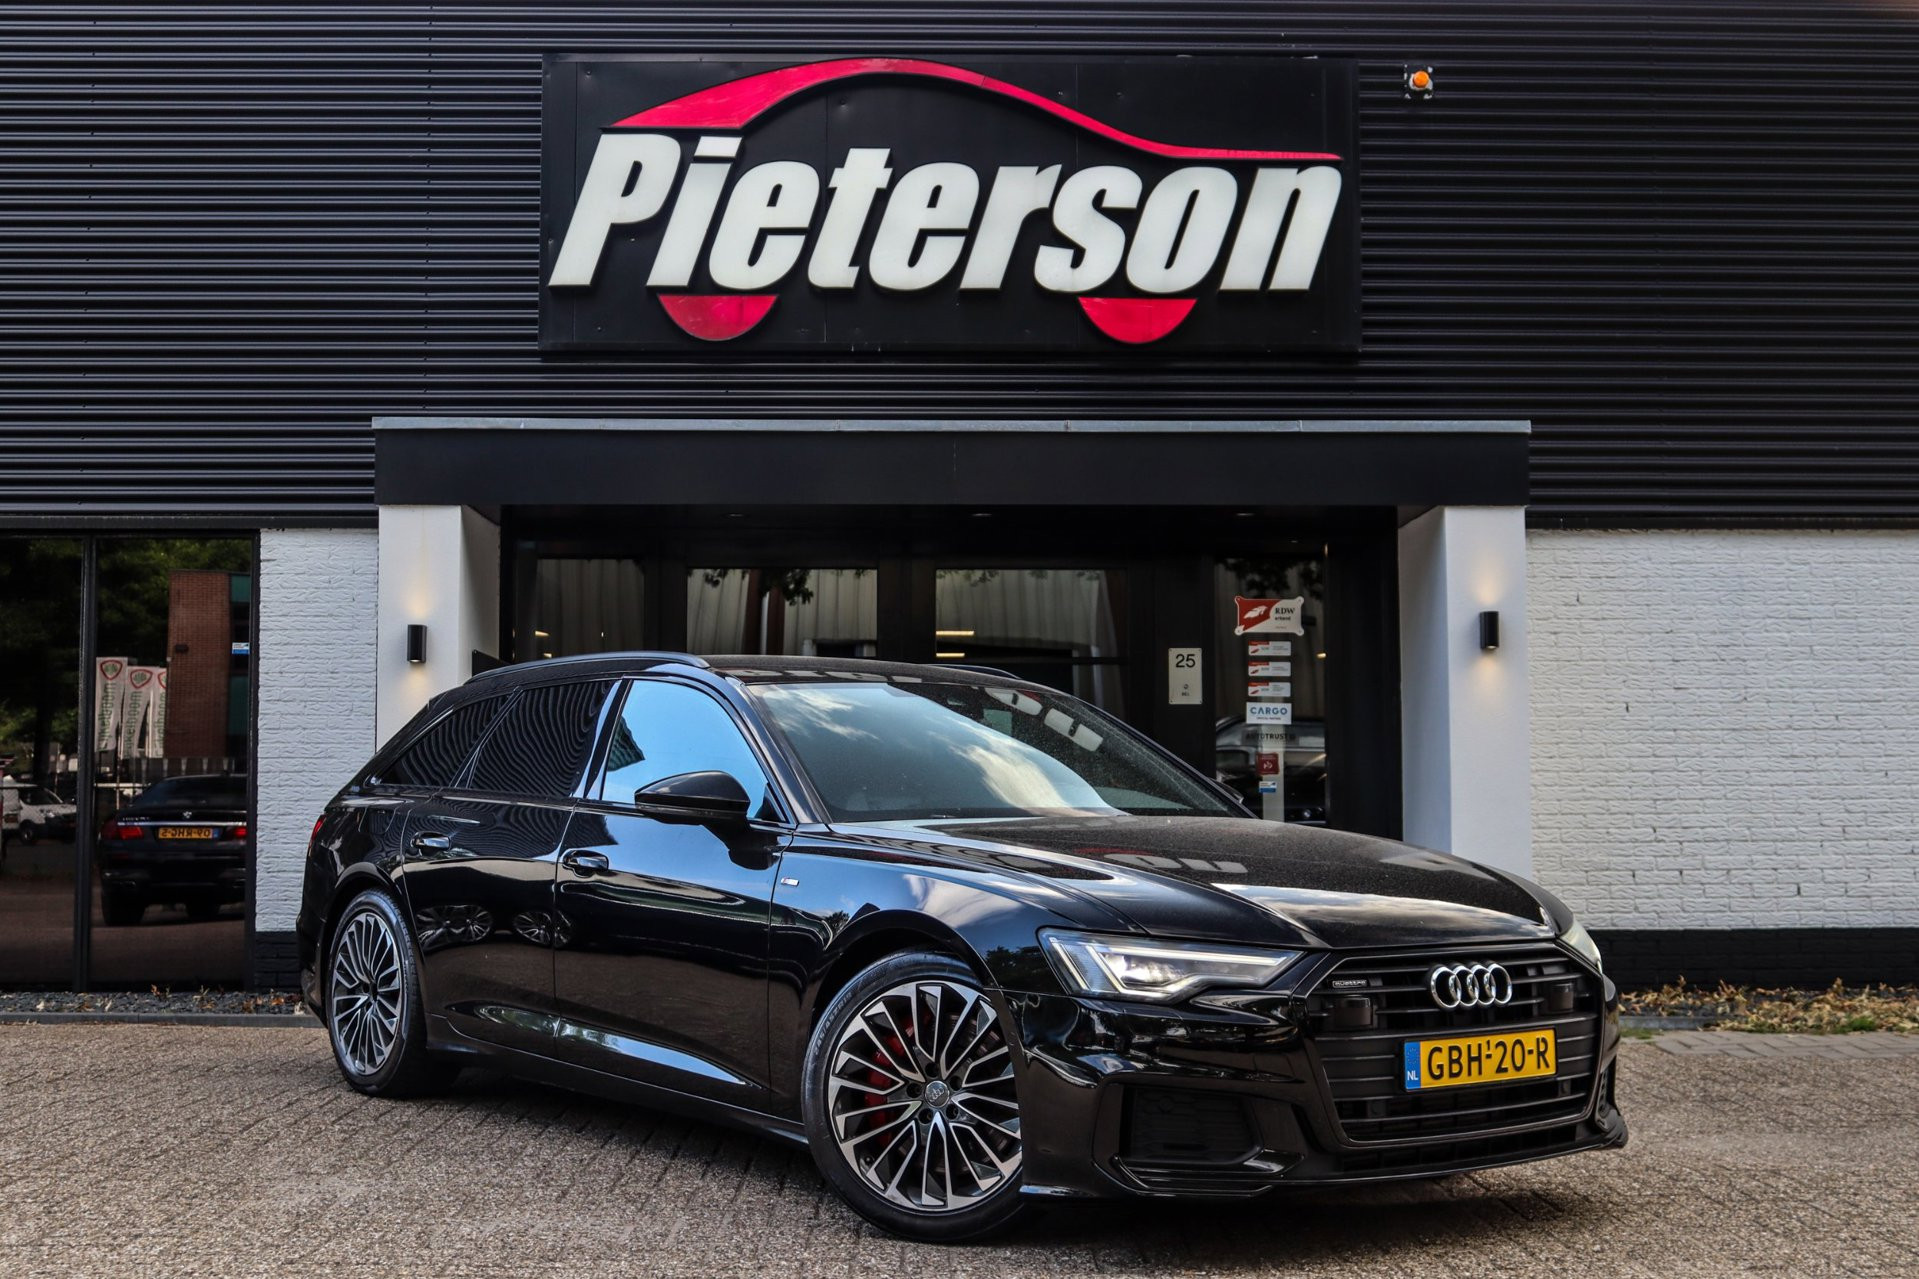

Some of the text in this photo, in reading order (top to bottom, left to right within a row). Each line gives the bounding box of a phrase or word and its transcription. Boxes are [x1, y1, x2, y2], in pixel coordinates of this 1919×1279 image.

[548, 132, 1343, 293] Pieterson
[1275, 607, 1296, 615] RDW
[1175, 653, 1196, 668] 25
[1249, 706, 1288, 716] CARGO
[1427, 1036, 1550, 1079] GBH-20-R
[1406, 1070, 1418, 1081] NL
